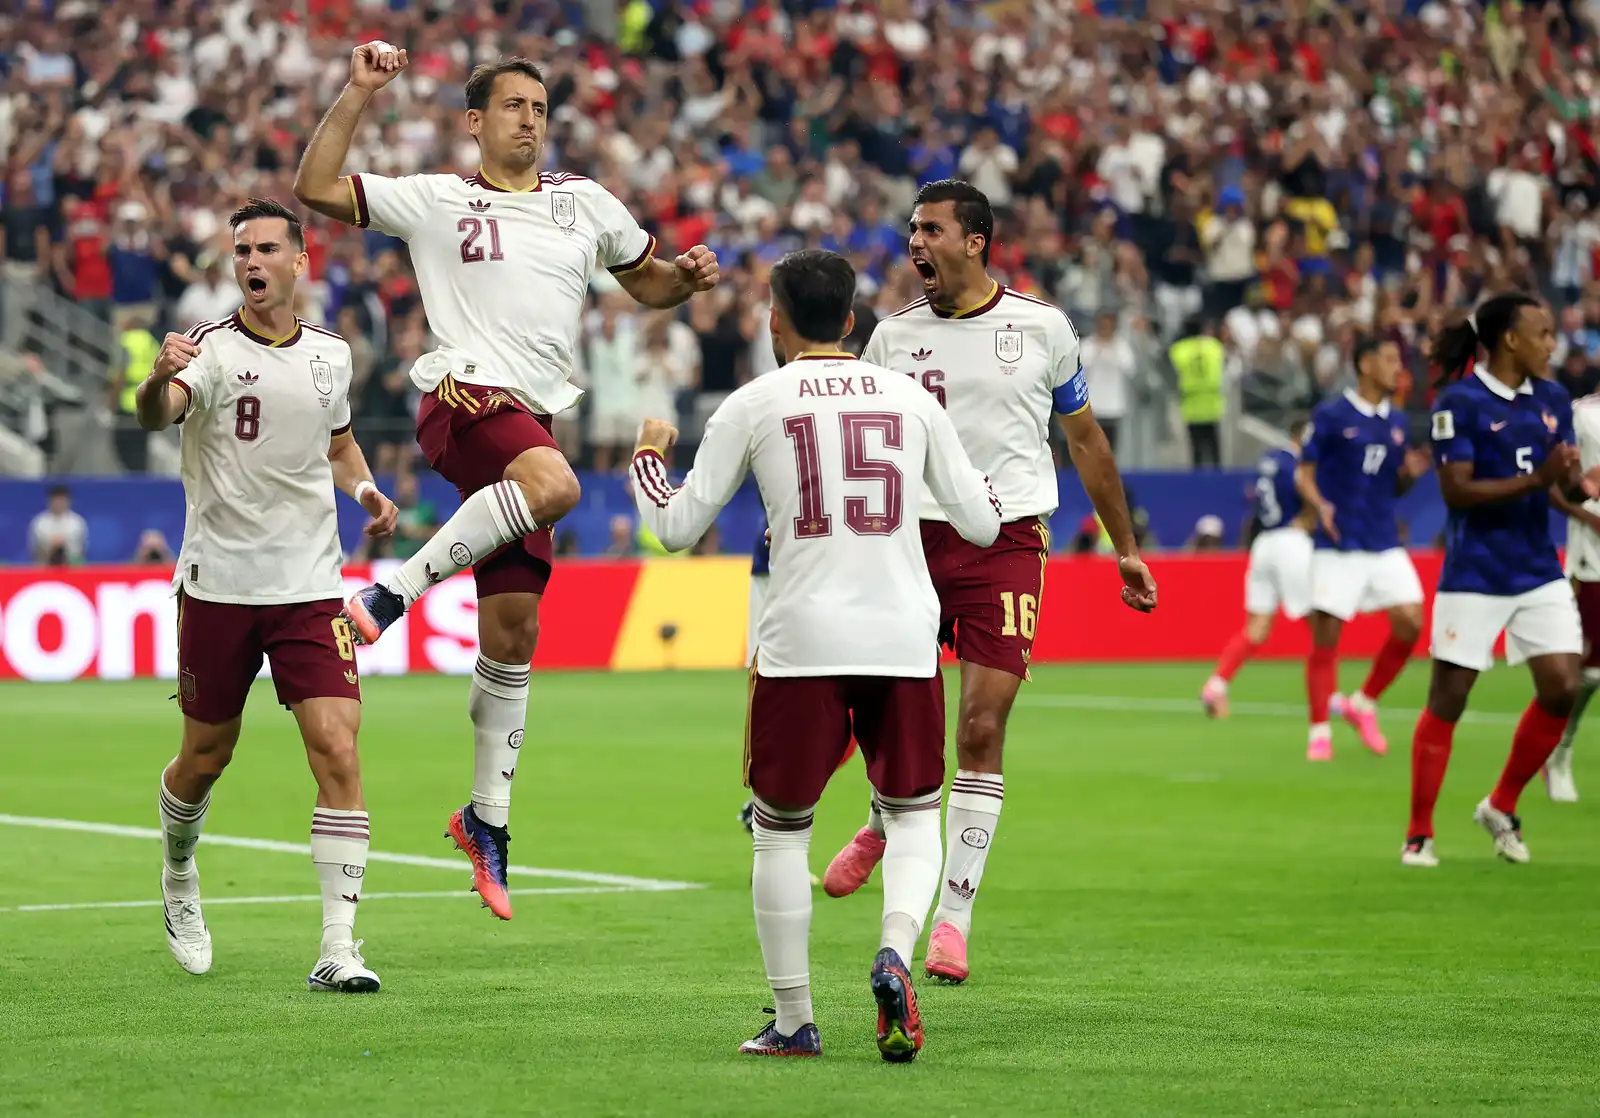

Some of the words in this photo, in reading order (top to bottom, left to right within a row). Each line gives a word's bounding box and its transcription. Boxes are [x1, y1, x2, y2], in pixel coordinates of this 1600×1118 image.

[457, 218, 504, 263] 21
[799, 377, 856, 397] ALEX
[861, 376, 883, 395] B.
[905, 369, 946, 410] 6
[235, 395, 261, 441] 8
[783, 411, 903, 539] 15
[1363, 444, 1387, 475] 17
[1515, 446, 1533, 474] 5
[1000, 591, 1036, 641] 16
[331, 617, 353, 661] 8
